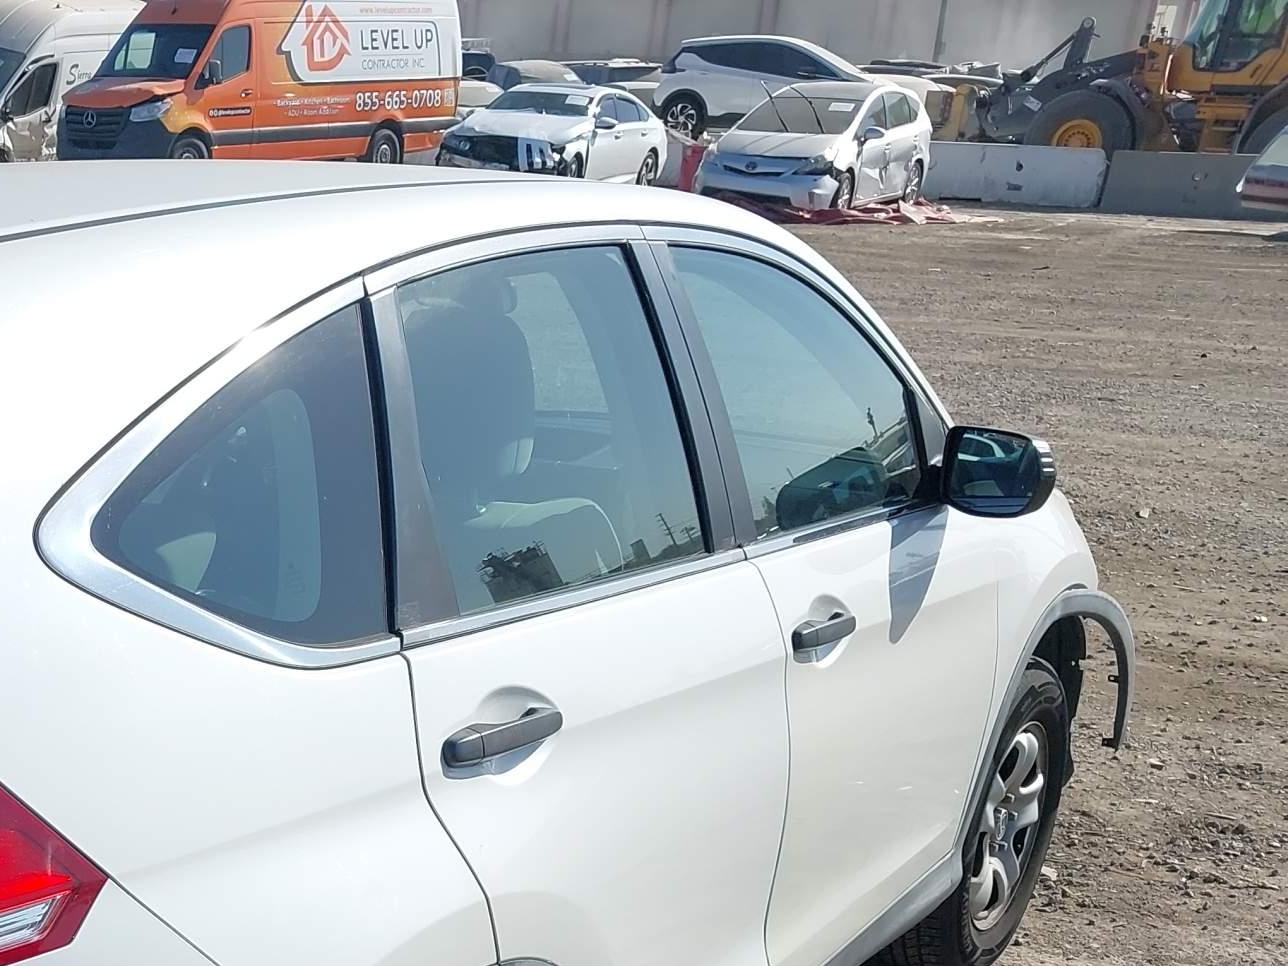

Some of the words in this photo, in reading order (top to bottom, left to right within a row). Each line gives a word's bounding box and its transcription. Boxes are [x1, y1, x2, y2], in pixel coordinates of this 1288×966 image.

[360, 29, 410, 50] LEVEL
[414, 28, 434, 50] UP
[361, 58, 409, 70] CONTRACTOR
[355, 89, 442, 112] 855-665-0708
